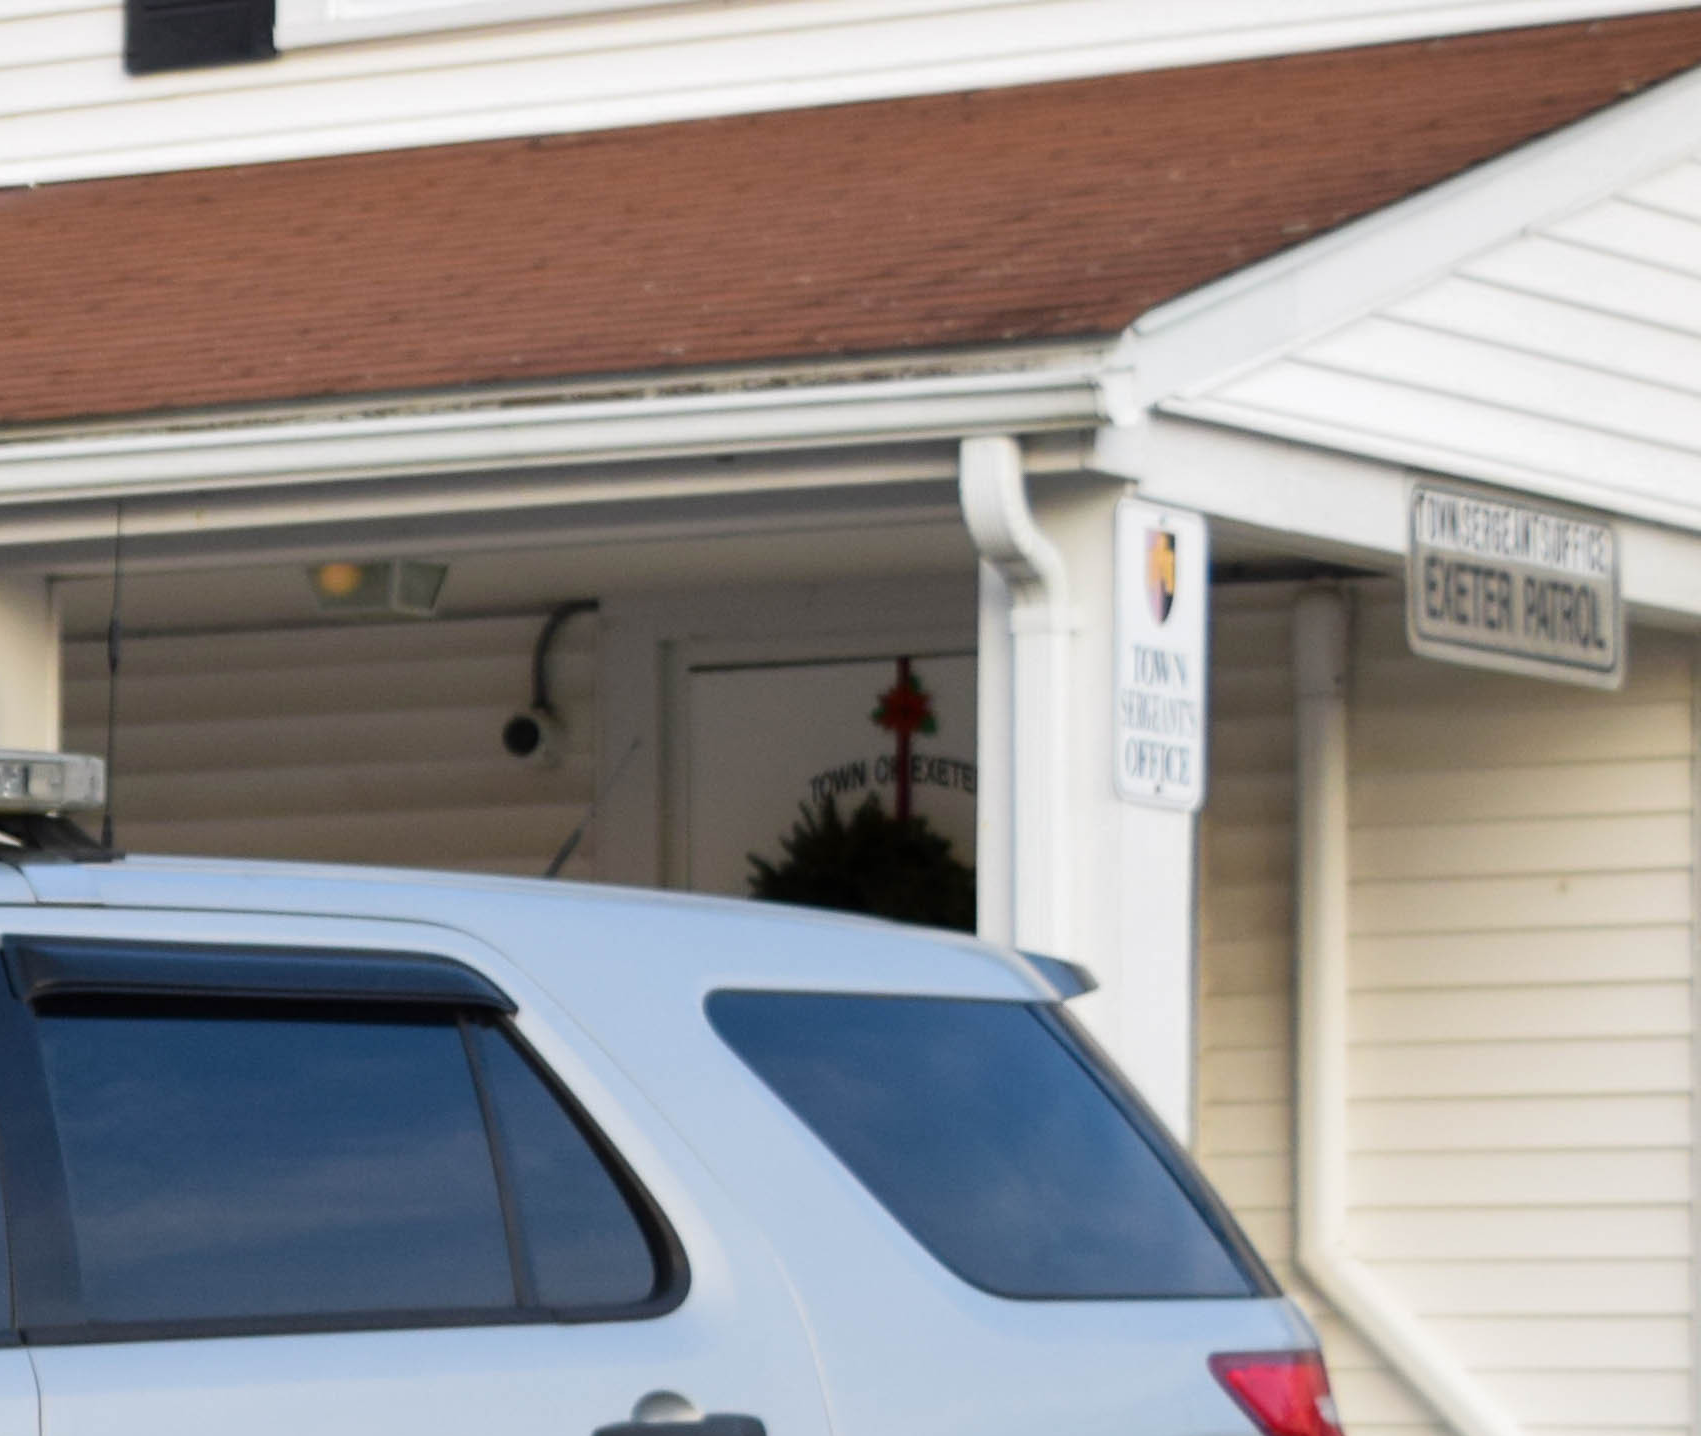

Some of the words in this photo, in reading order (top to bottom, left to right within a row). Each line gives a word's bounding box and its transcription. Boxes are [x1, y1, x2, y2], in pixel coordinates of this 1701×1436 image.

[1415, 493, 1458, 542] TOWN
[1425, 554, 1514, 635] EXETER
[1522, 574, 1607, 651] PATROL
[1131, 643, 1189, 689] TOWN
[810, 759, 866, 804] TOWN
[910, 755, 976, 796] EXETE
[1124, 736, 1191, 786] OFFICE
